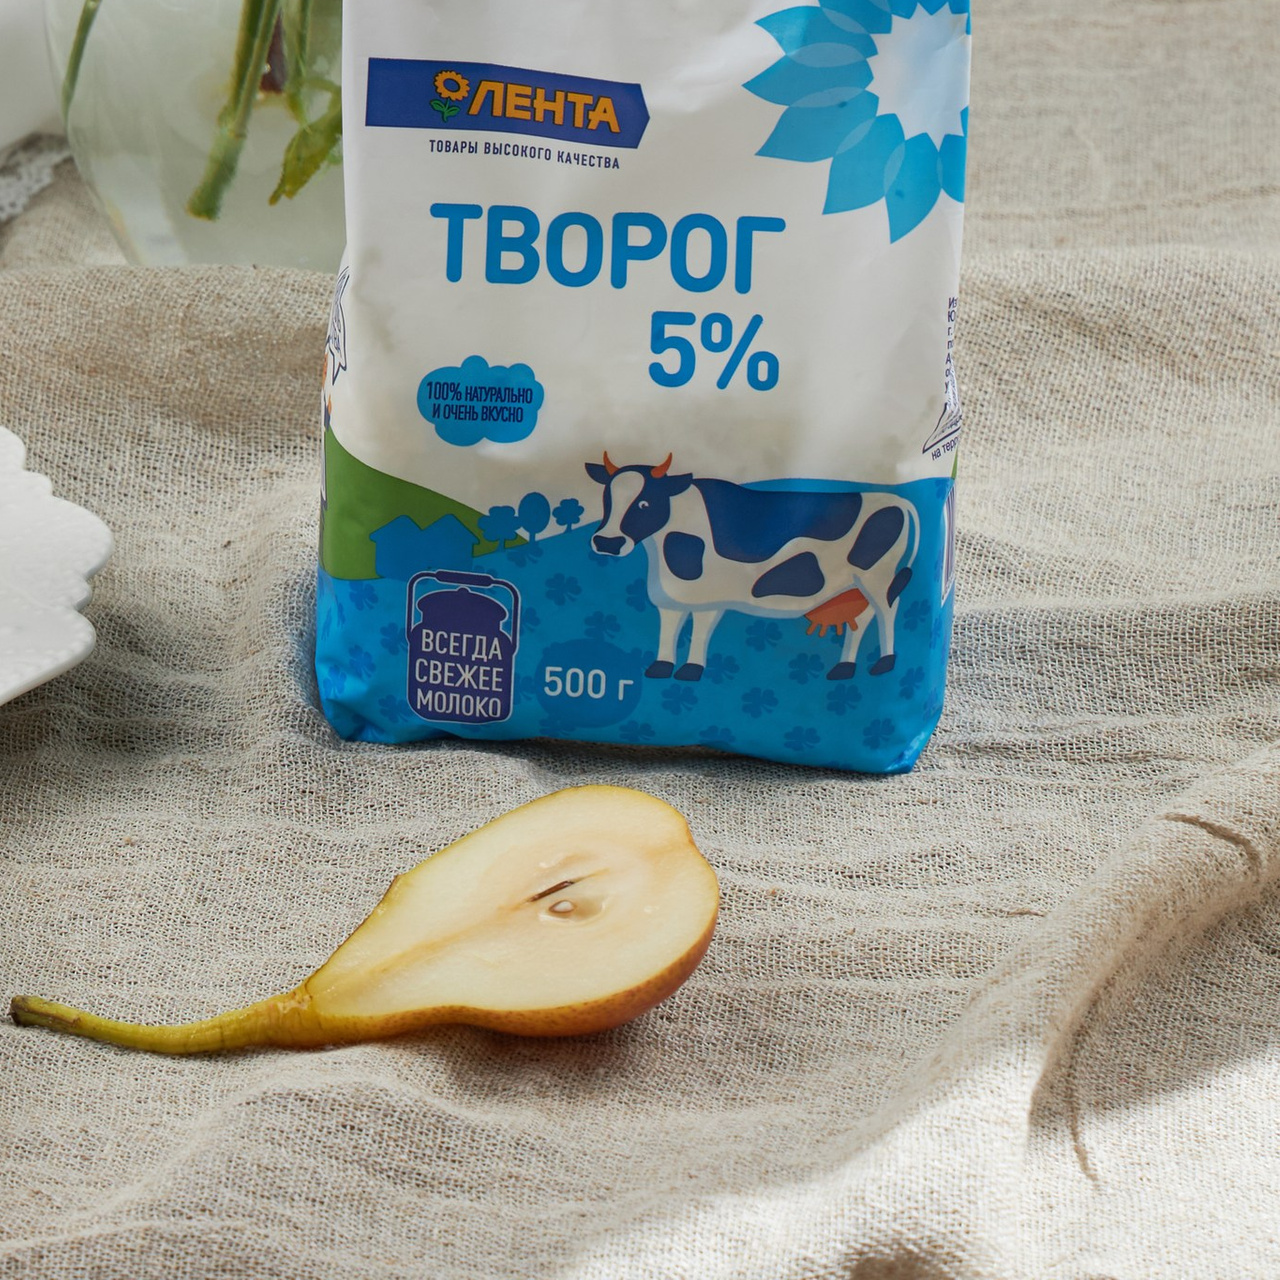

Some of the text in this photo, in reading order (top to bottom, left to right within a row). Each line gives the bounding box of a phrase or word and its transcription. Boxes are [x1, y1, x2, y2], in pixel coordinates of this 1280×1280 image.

[467, 79, 621, 134] ЛЕНТА
[429, 139, 620, 169] ТОВАРЫ ВЫСОКОГО КАЧЕСТВА
[429, 202, 787, 295] ТВОРОГ
[648, 310, 780, 392] 5%
[426, 380, 533, 404] 100% НАТУРАЛЬНО
[432, 403, 524, 423] И ОЧЕНЬ ВКУСНО
[421, 628, 503, 662] ВСЕГДА
[415, 658, 504, 692] СВЕЖЕЕ
[543, 666, 634, 701] 500 г
[416, 688, 502, 718] МОЛОКО
